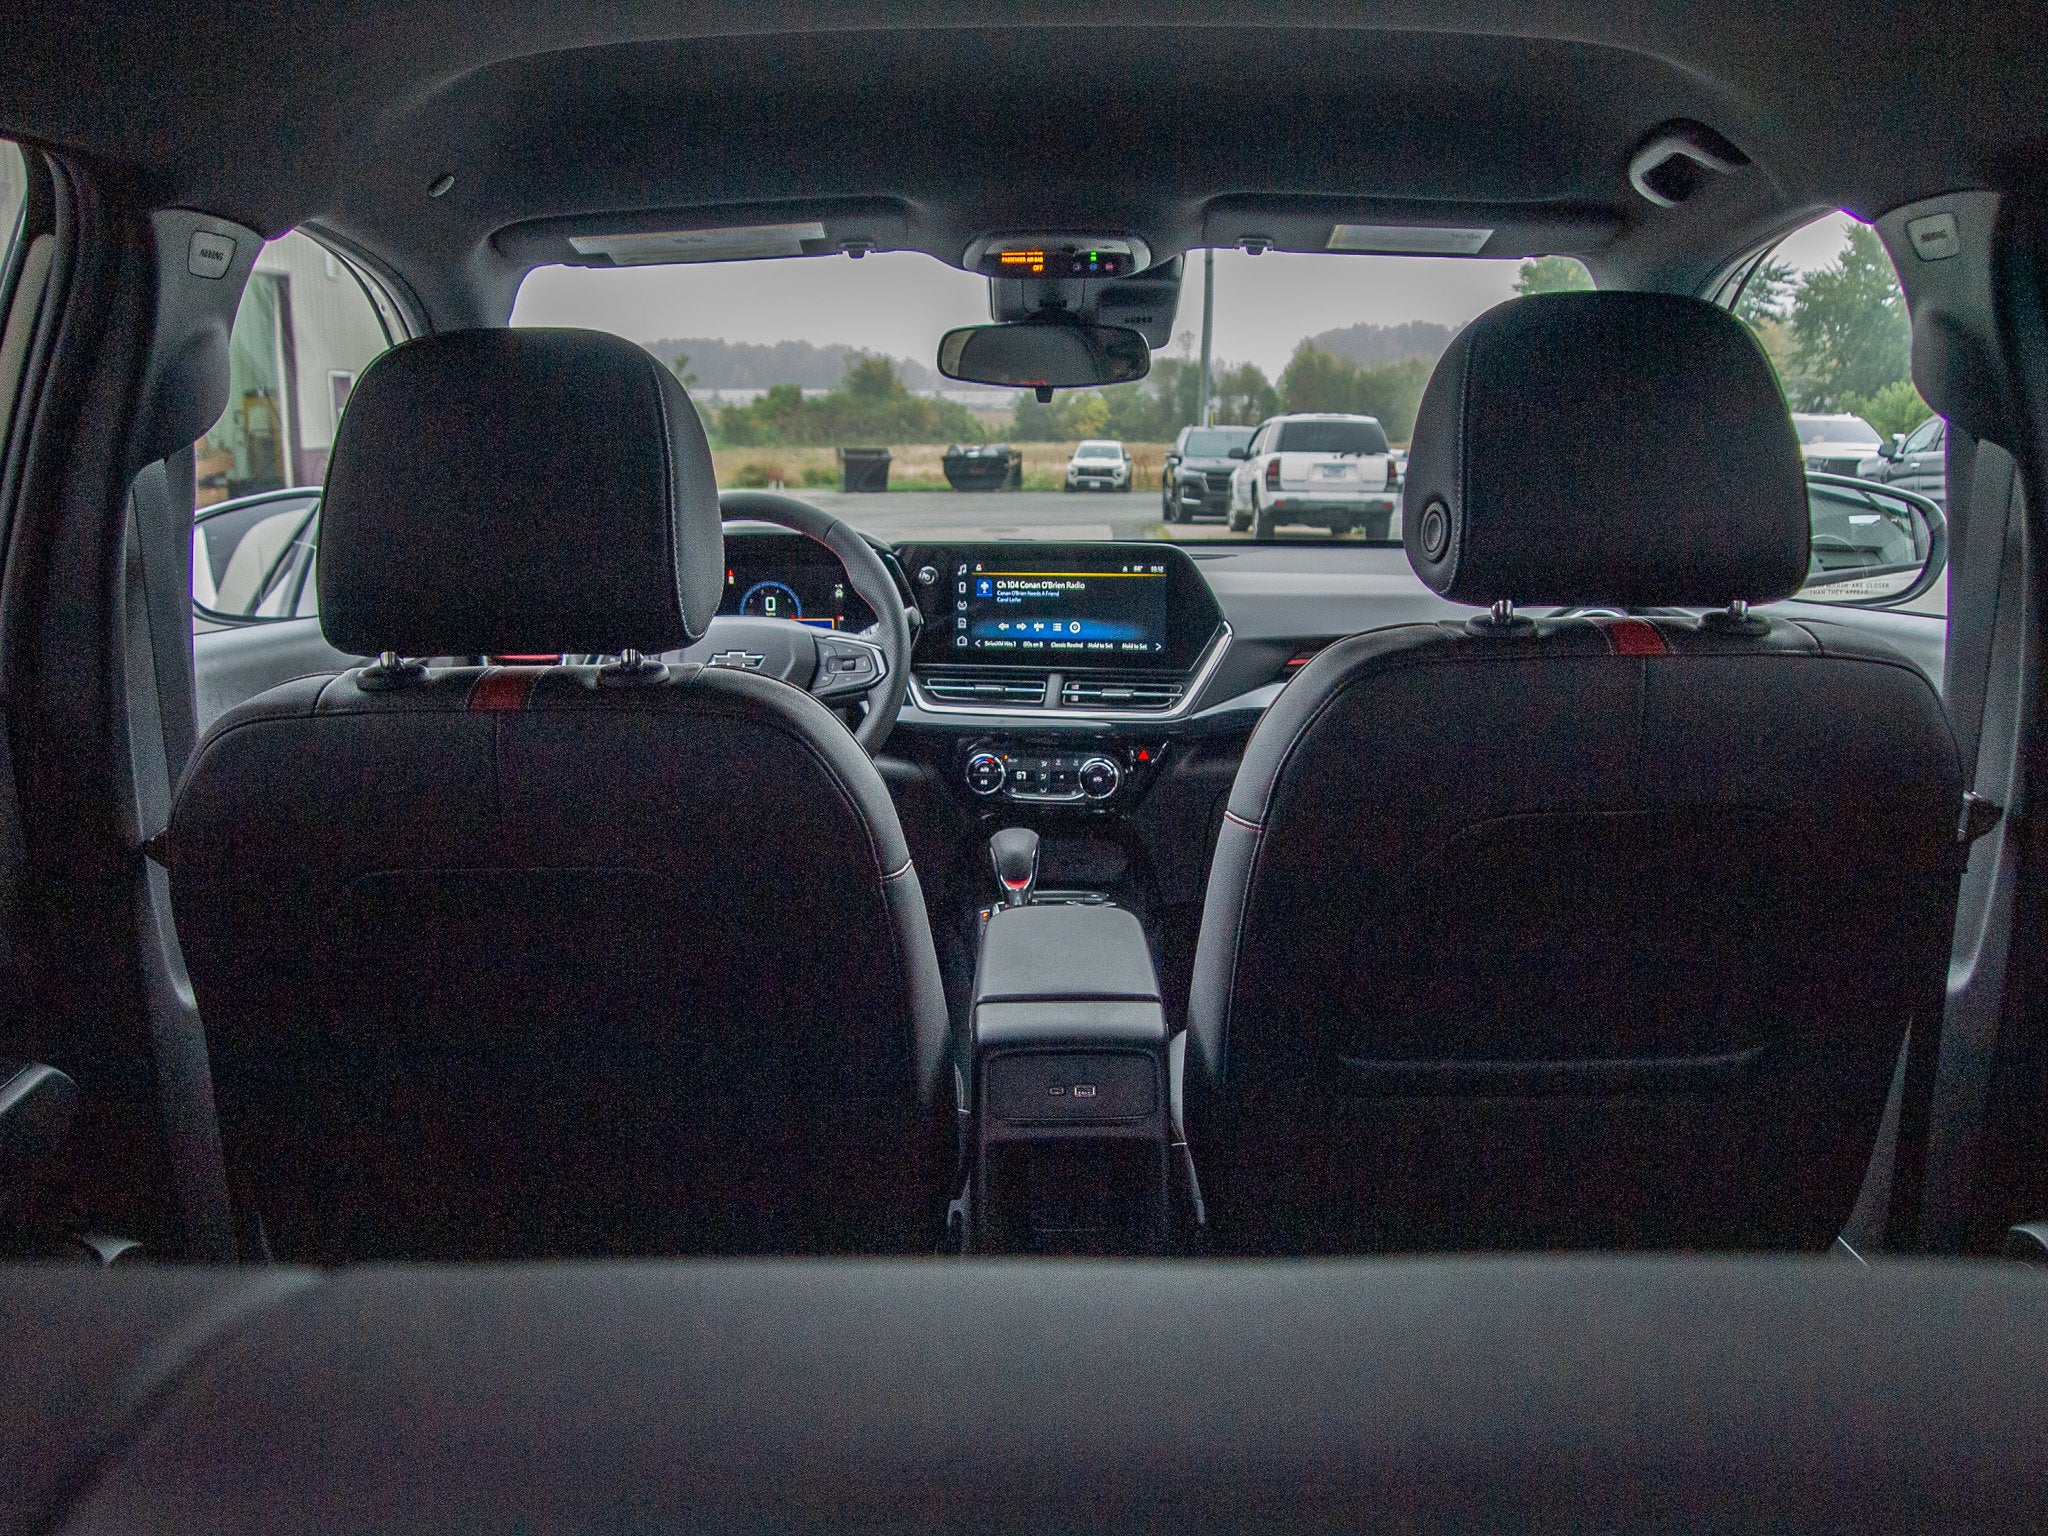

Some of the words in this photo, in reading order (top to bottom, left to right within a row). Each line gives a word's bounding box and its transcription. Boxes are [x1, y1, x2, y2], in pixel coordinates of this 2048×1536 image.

[1032, 264, 1044, 272] OFF
[996, 580, 1007, 589] Ch
[1007, 580, 1019, 589] 104
[1020, 580, 1041, 589] Conan
[1041, 580, 1066, 589] O'Brien
[1066, 580, 1086, 590] Radio
[765, 596, 777, 612] 0
